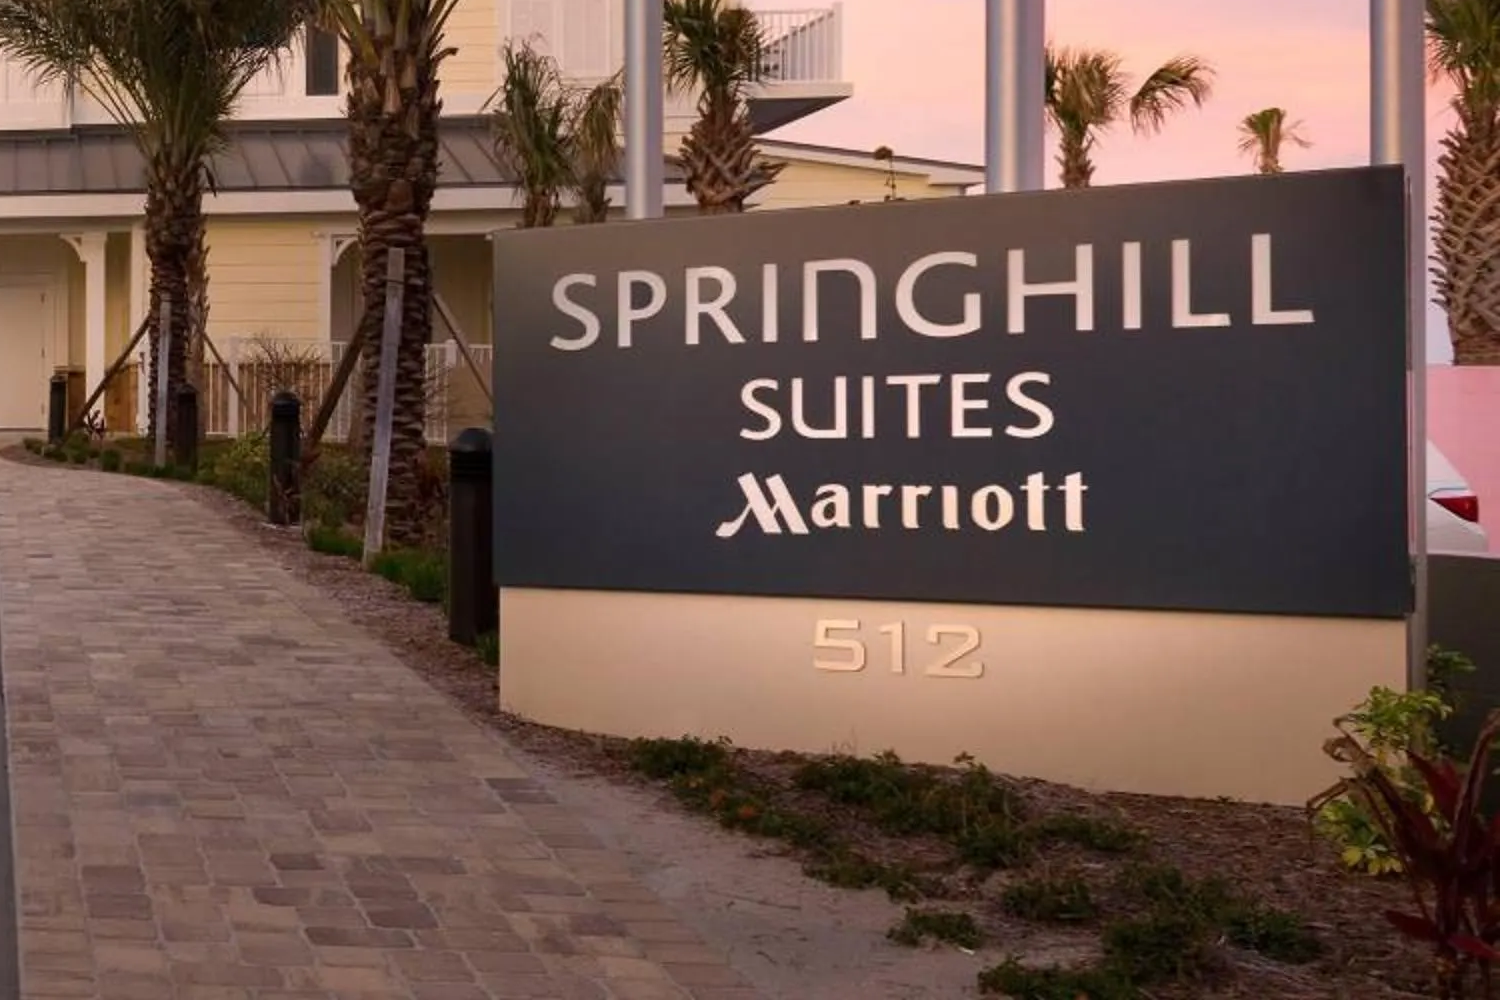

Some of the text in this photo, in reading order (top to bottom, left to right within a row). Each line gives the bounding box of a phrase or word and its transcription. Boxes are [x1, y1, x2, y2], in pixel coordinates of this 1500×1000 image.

[739, 371, 1056, 441] SUITES
[715, 471, 1088, 538] Marriott
[813, 619, 985, 679] 512
